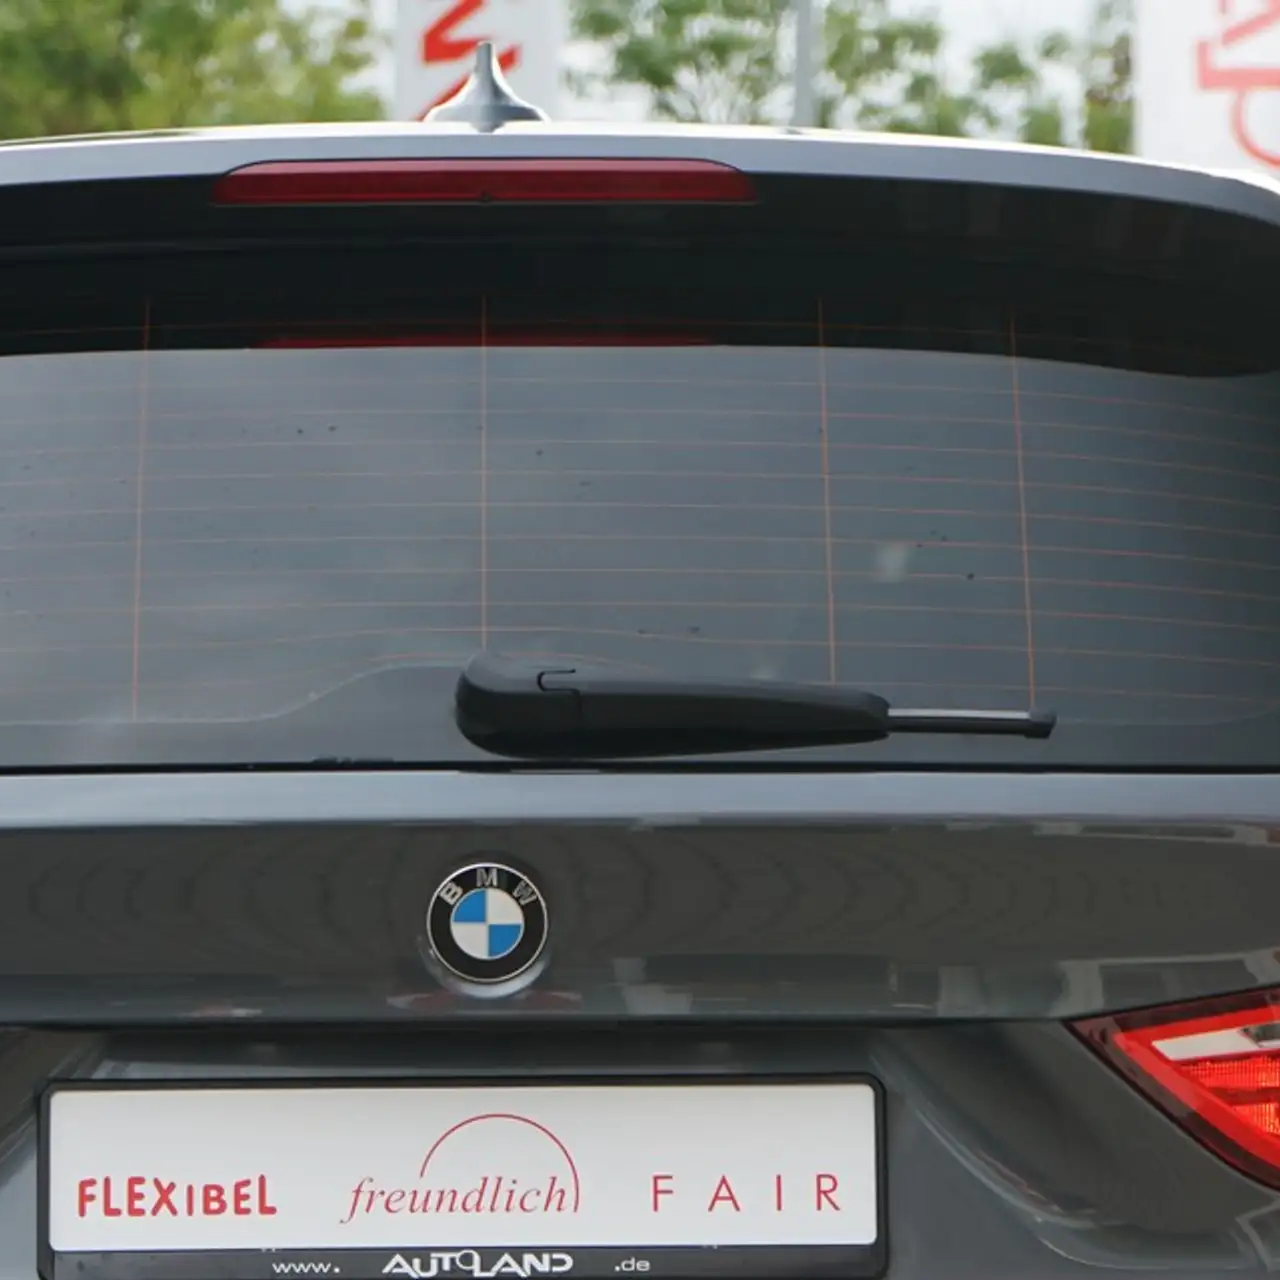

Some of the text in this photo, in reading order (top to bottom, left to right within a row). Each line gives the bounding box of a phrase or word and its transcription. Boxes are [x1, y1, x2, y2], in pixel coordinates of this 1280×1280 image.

[439, 867, 539, 906] BMW
[77, 1173, 842, 1224] FLEXIBEL freundlich FAIR
[272, 1250, 651, 1279] www. AUTOLAND .de
